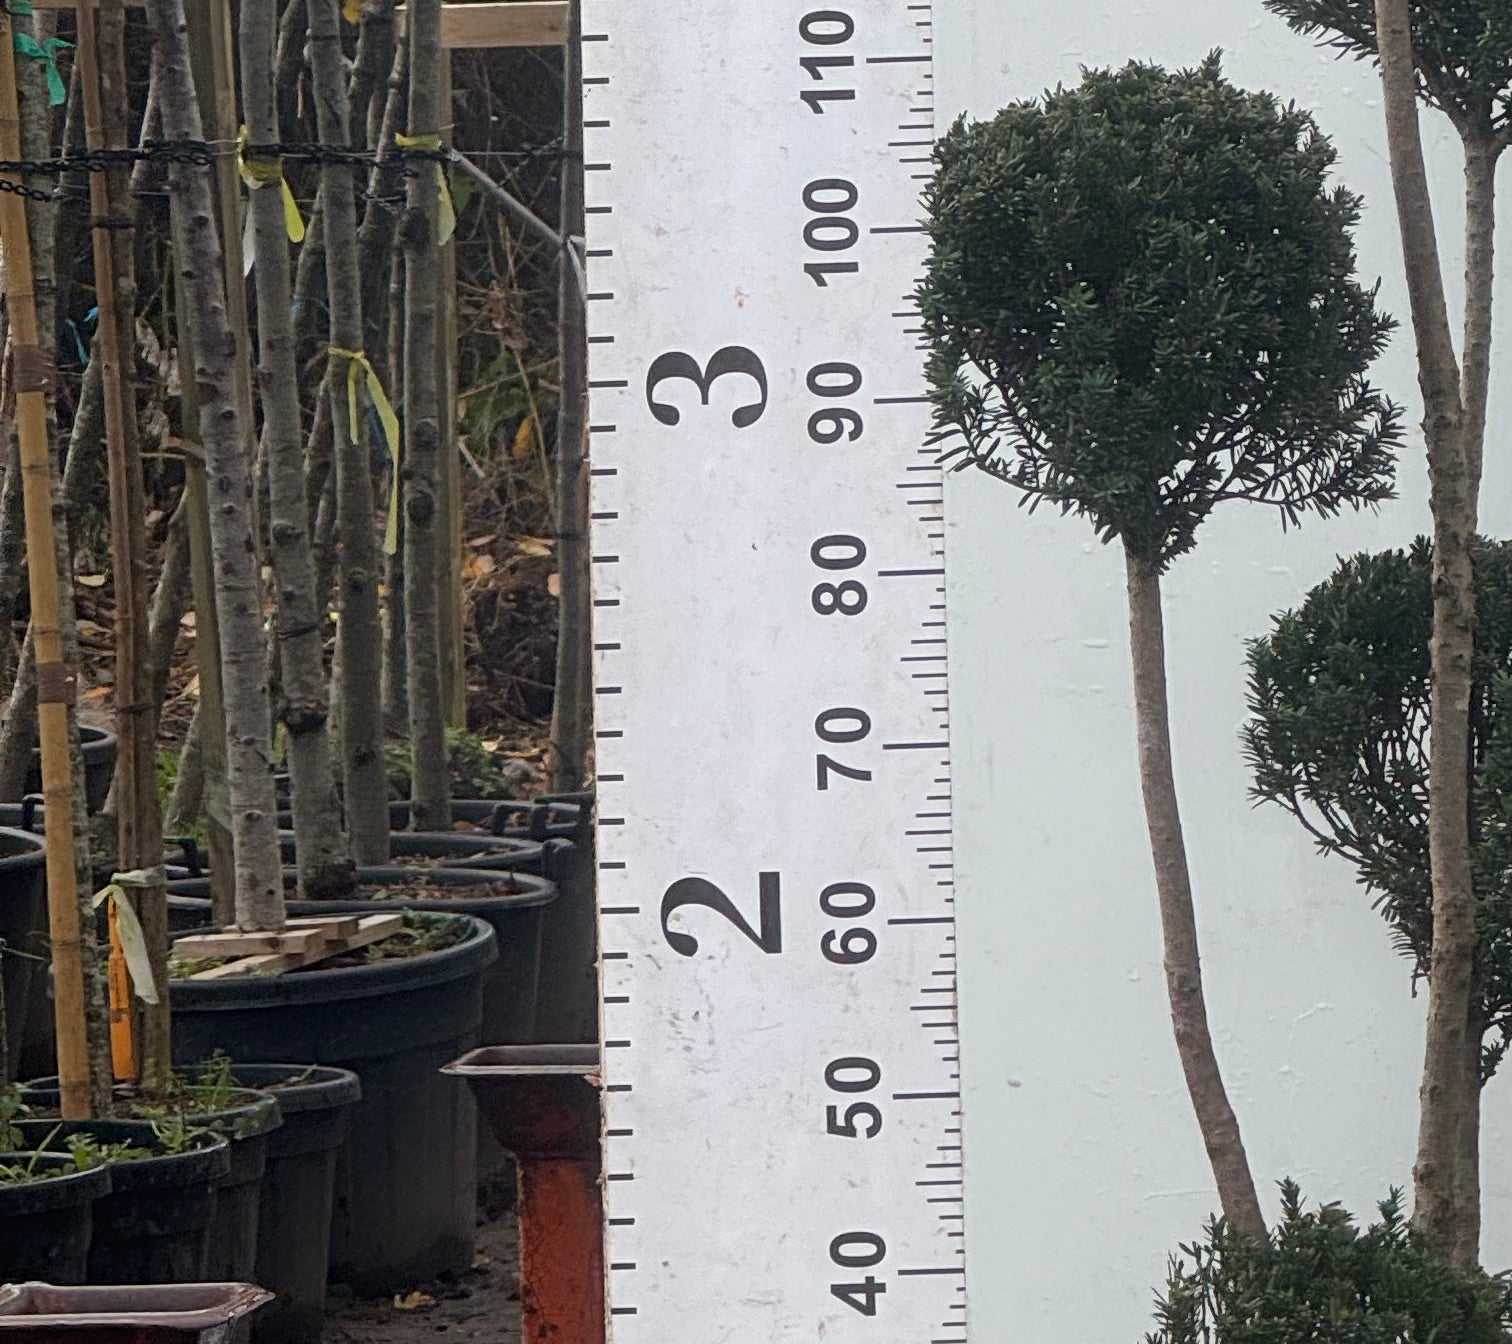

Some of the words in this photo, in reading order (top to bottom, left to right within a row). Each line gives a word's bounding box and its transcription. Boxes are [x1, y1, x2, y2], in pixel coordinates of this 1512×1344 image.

[798, 10, 856, 115] 110
[802, 178, 859, 287] 100
[645, 345, 768, 429] 3
[806, 362, 864, 445] 90
[810, 534, 868, 616] 80
[814, 707, 872, 791] 70
[660, 871, 782, 958] 2
[819, 882, 877, 965] 60
[824, 1056, 883, 1139] 50
[829, 1231, 887, 1317] 40
